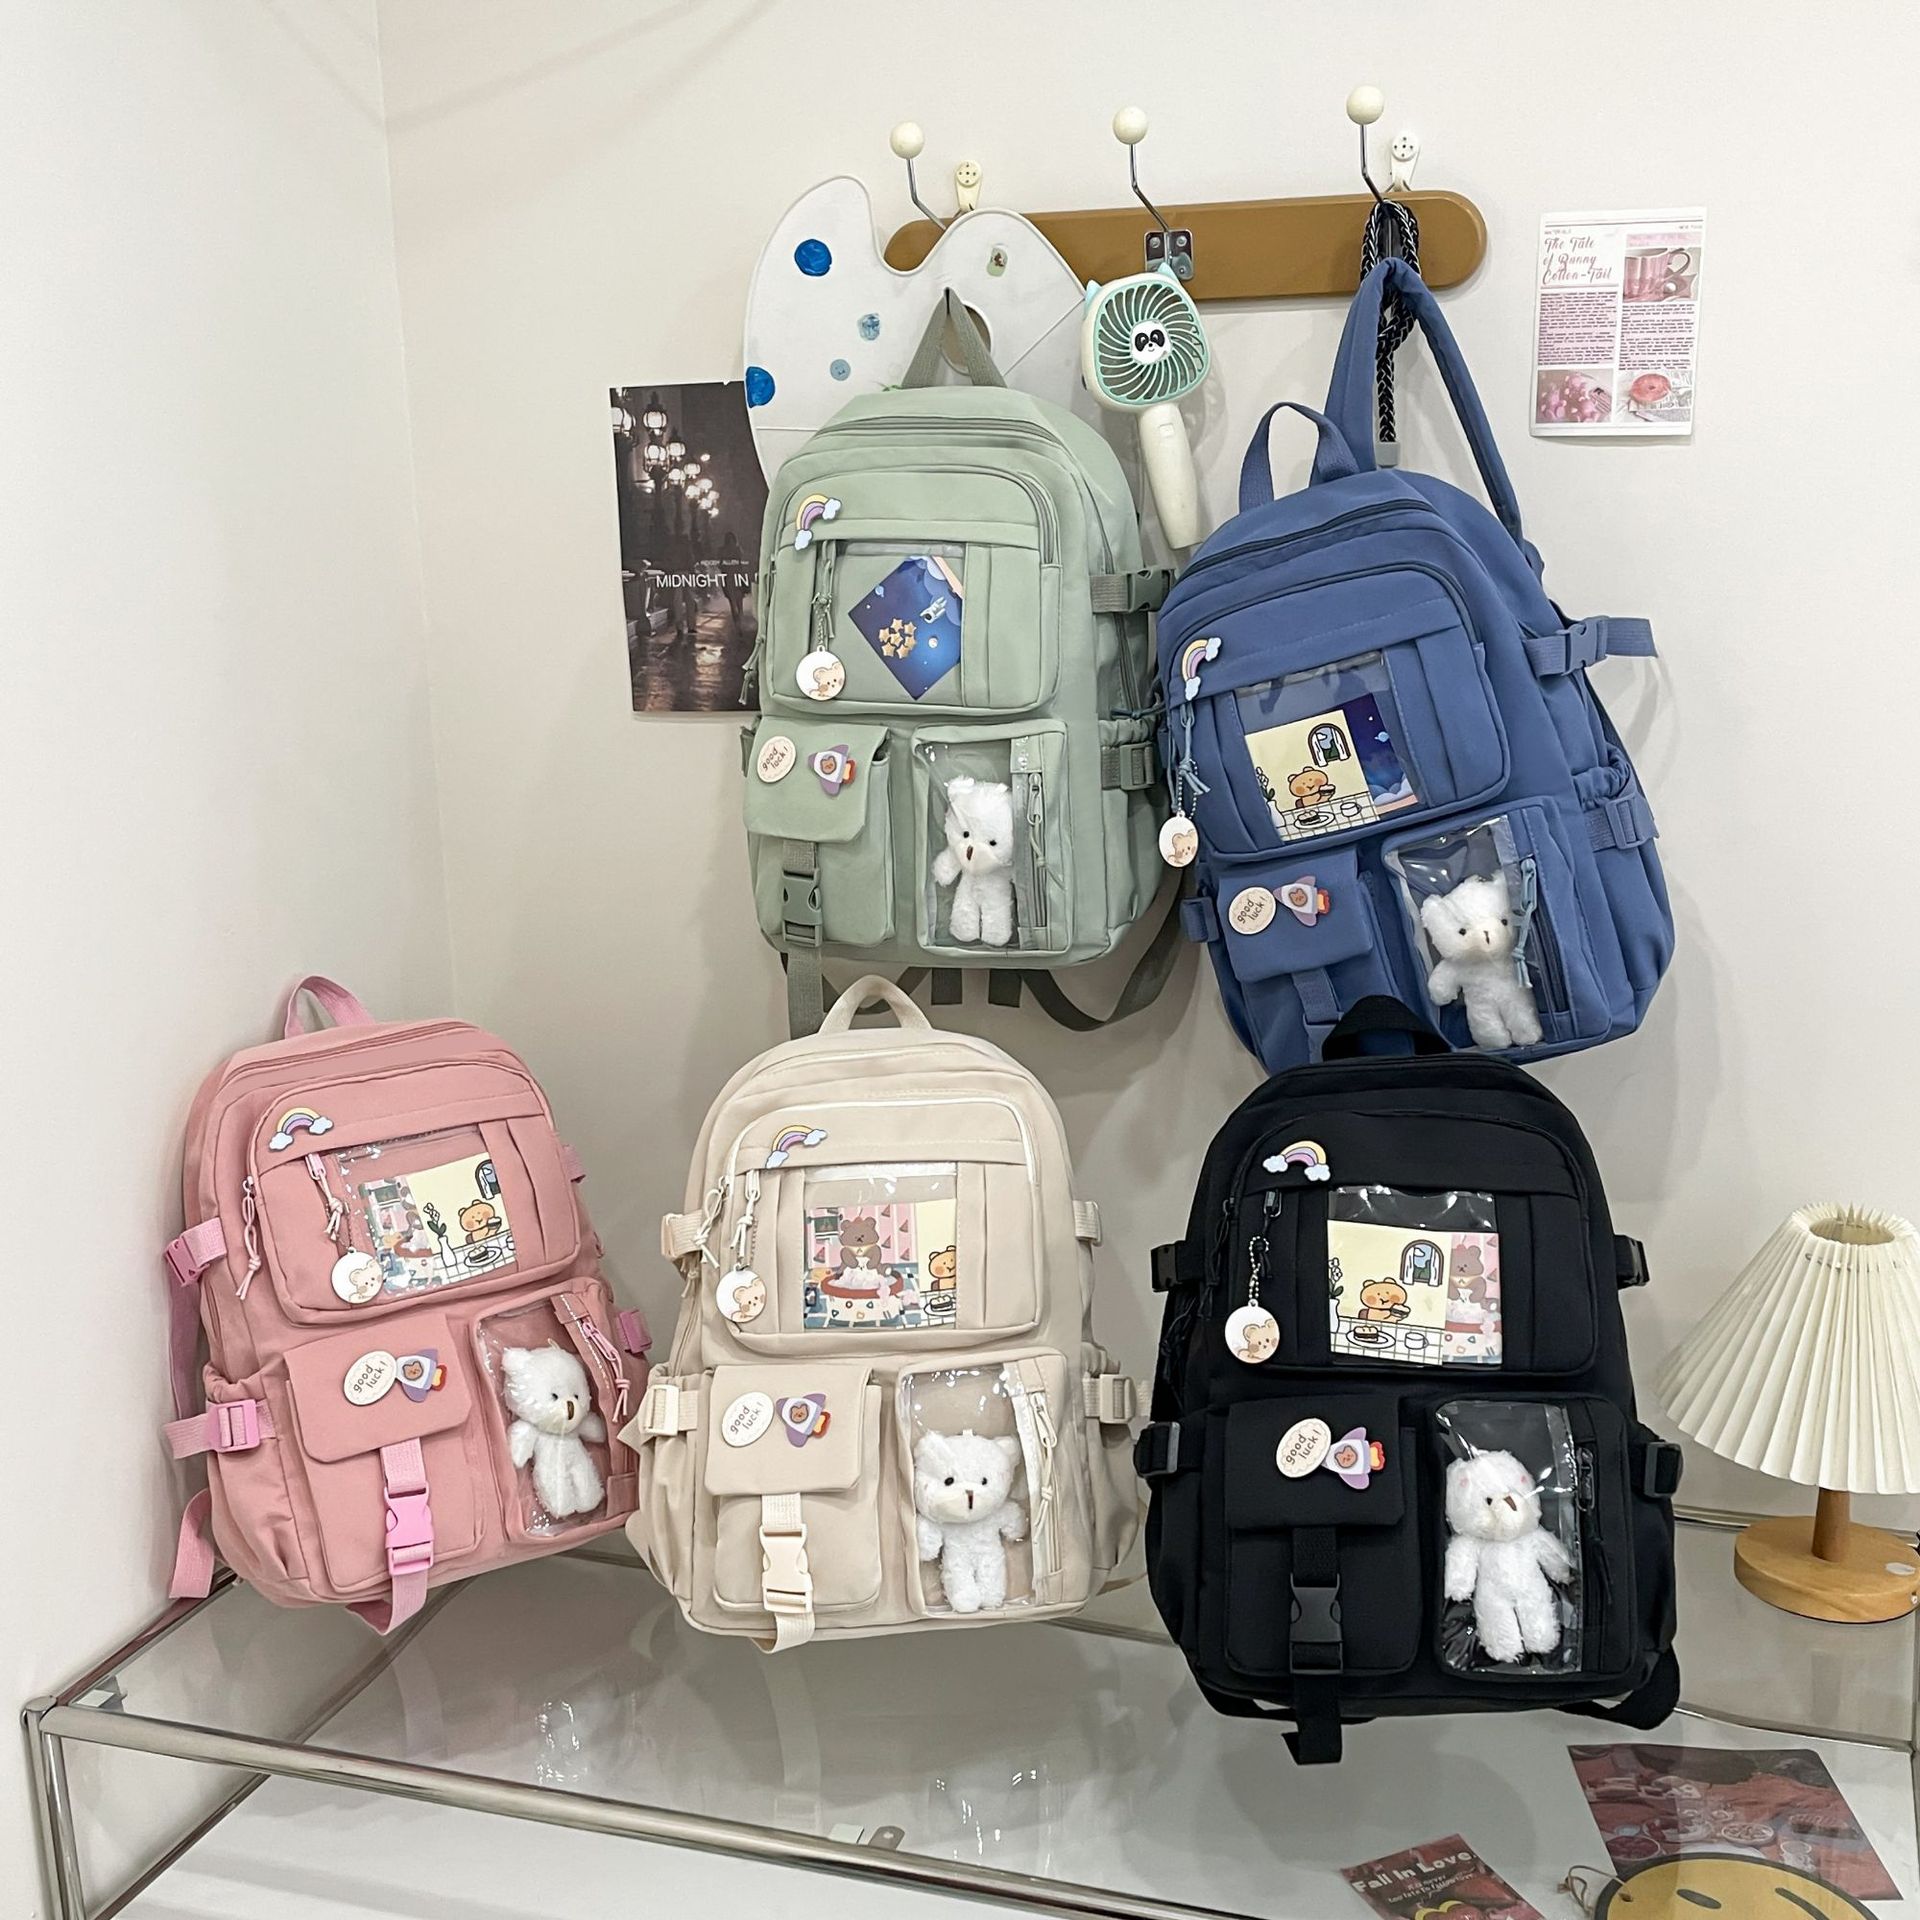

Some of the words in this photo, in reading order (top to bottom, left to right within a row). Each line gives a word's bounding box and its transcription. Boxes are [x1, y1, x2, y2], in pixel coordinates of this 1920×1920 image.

[1544, 236, 1565, 253] The
[1570, 236, 1594, 253] Tale
[656, 573, 727, 588] MIDNIGHT
[734, 573, 749, 587] IN
[762, 746, 778, 772] good
[1237, 898, 1254, 924] good
[353, 1363, 373, 1393] good
[730, 1405, 750, 1435] good
[1285, 1433, 1307, 1465] good
[1351, 1873, 1393, 1893] Fall
[1392, 1869, 1417, 1880] In
